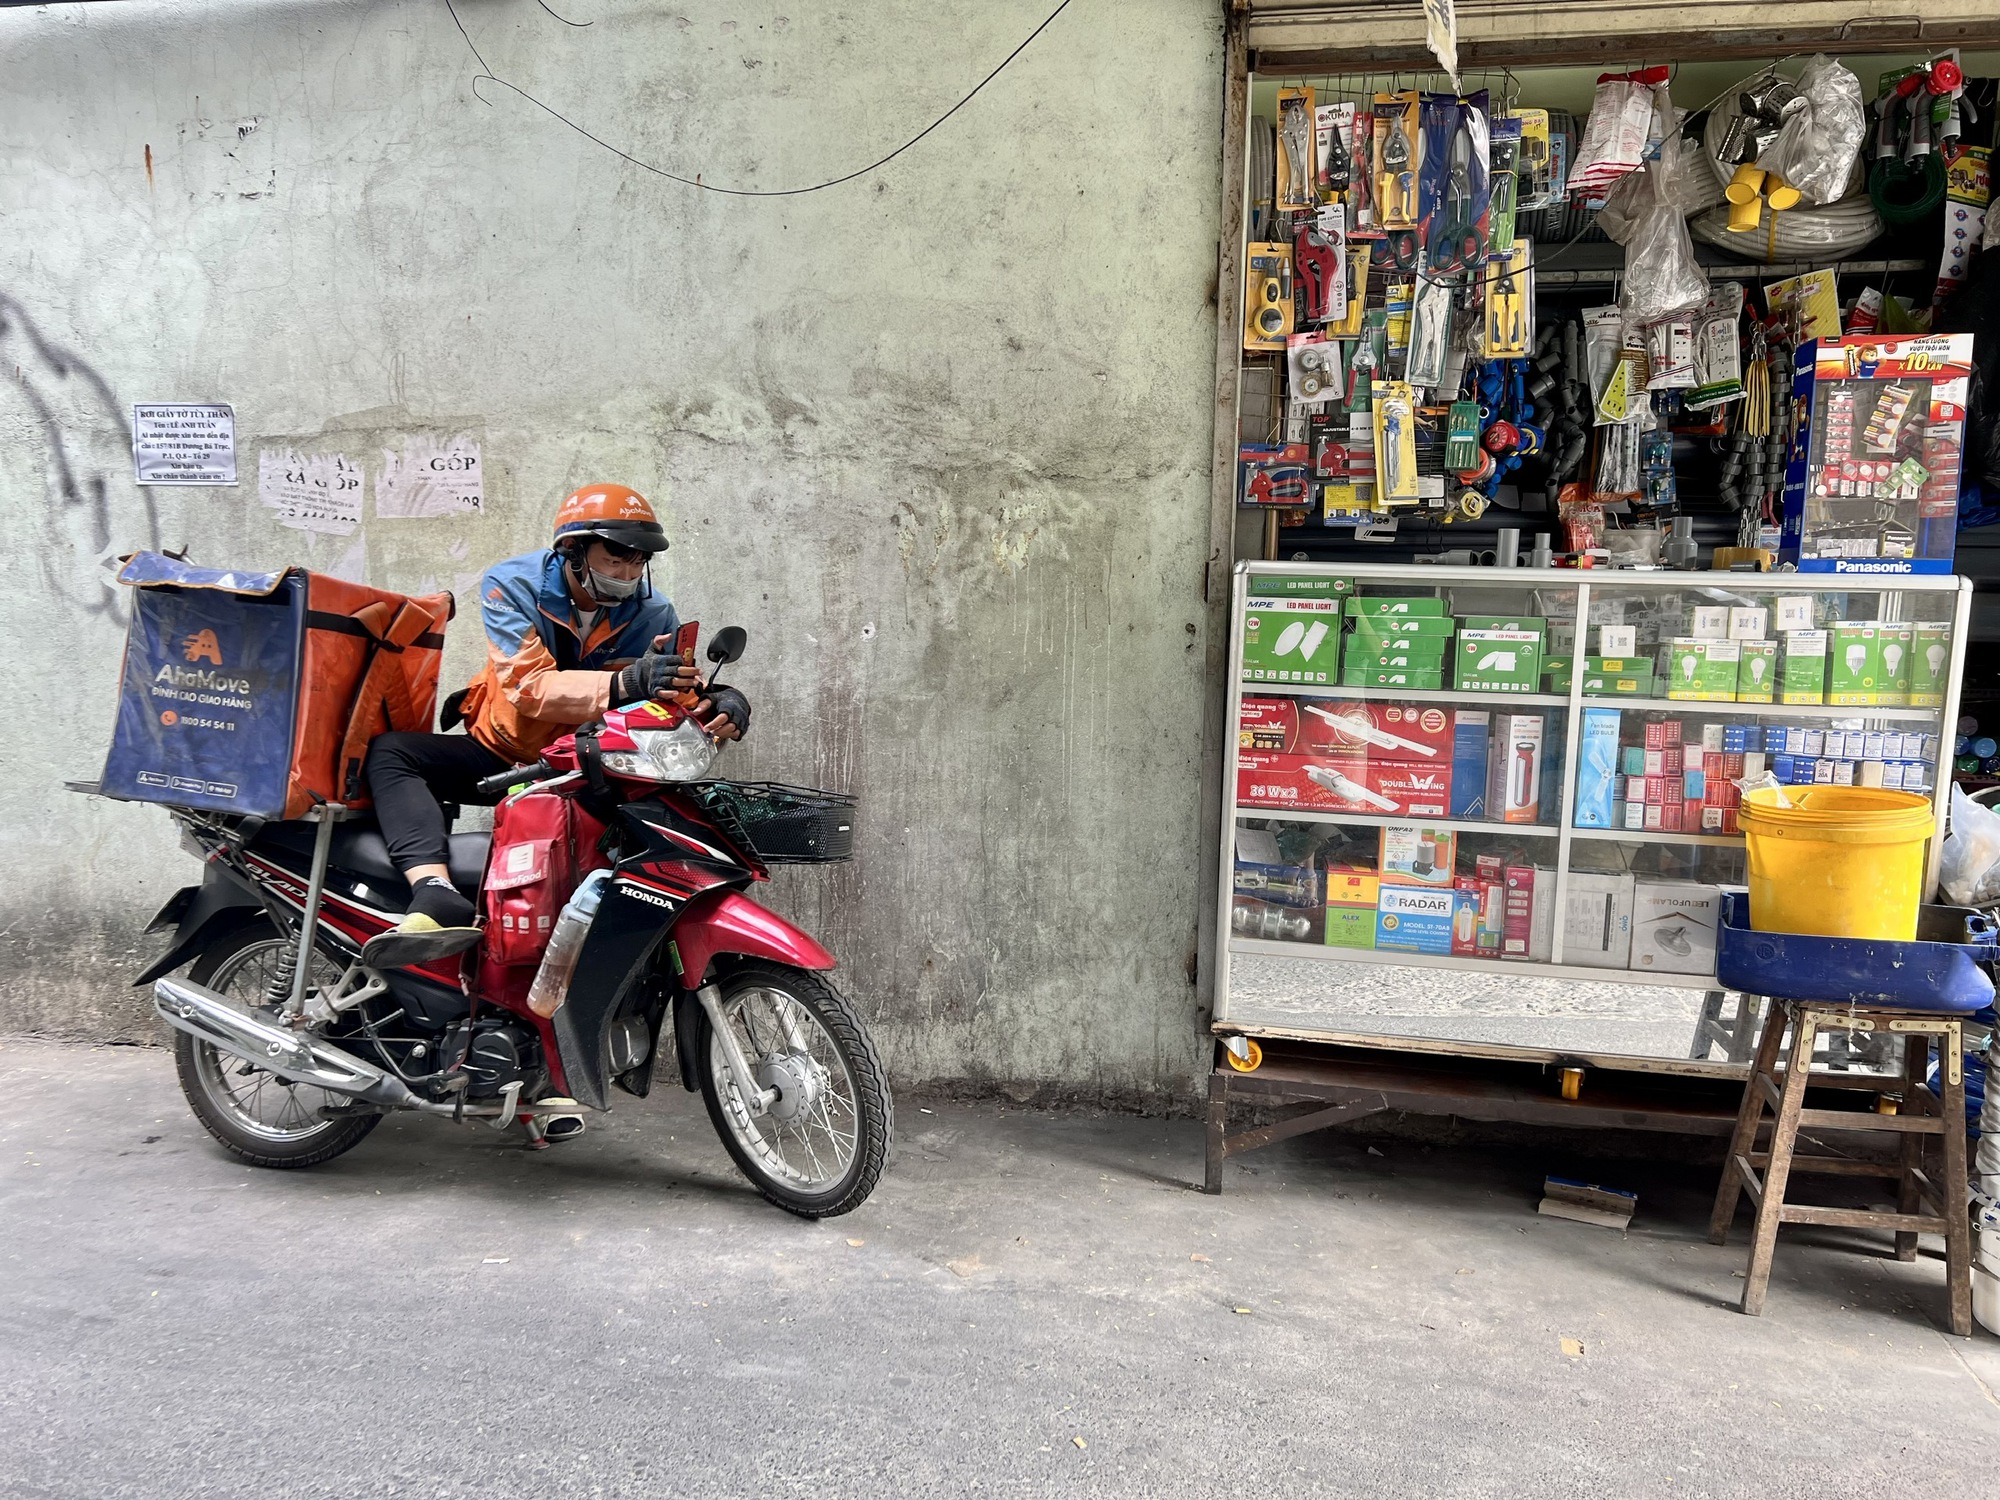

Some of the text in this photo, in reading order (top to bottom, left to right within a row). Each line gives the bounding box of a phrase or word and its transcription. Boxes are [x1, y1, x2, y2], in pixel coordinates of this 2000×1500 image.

[1836, 560, 1912, 574] Panasonic
[1247, 601, 1275, 609] MPE
[155, 664, 250, 694] AhaMove
[180, 691, 198, 702] CAO
[198, 694, 222, 705] GIAO
[222, 696, 252, 710] HÀNG
[200, 720, 212, 728] 54
[214, 721, 225, 730] 54
[226, 722, 235, 732] 11
[1250, 784, 1266, 797] 36
[620, 885, 676, 912] HONDA
[1398, 898, 1447, 910] RADAR
